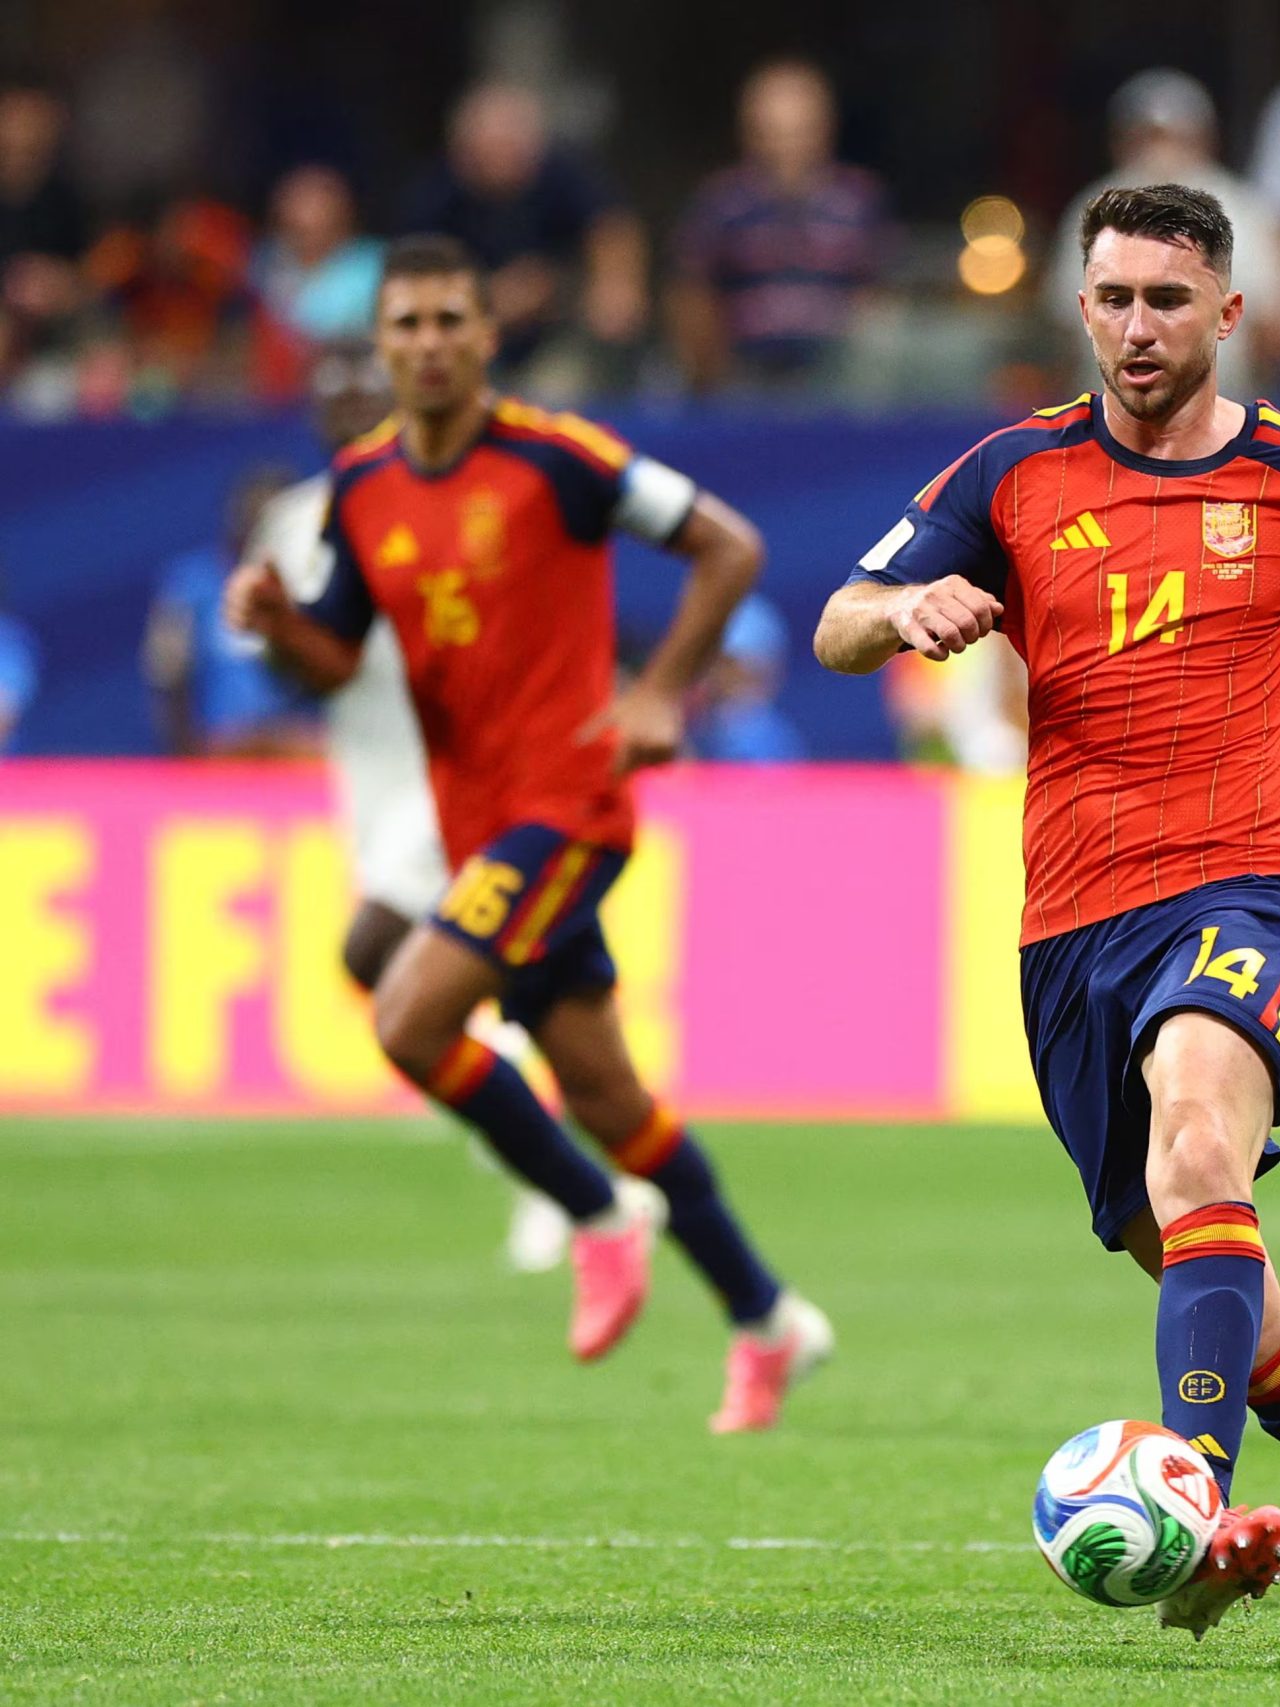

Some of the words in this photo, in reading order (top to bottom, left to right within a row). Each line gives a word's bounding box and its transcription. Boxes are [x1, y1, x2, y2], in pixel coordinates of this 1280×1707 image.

[1107, 570, 1186, 656] 14
[439, 855, 525, 938] 16
[1183, 926, 1267, 1000] 14
[1187, 1377, 1214, 1387] RF
[1187, 1387, 1214, 1397] EF
